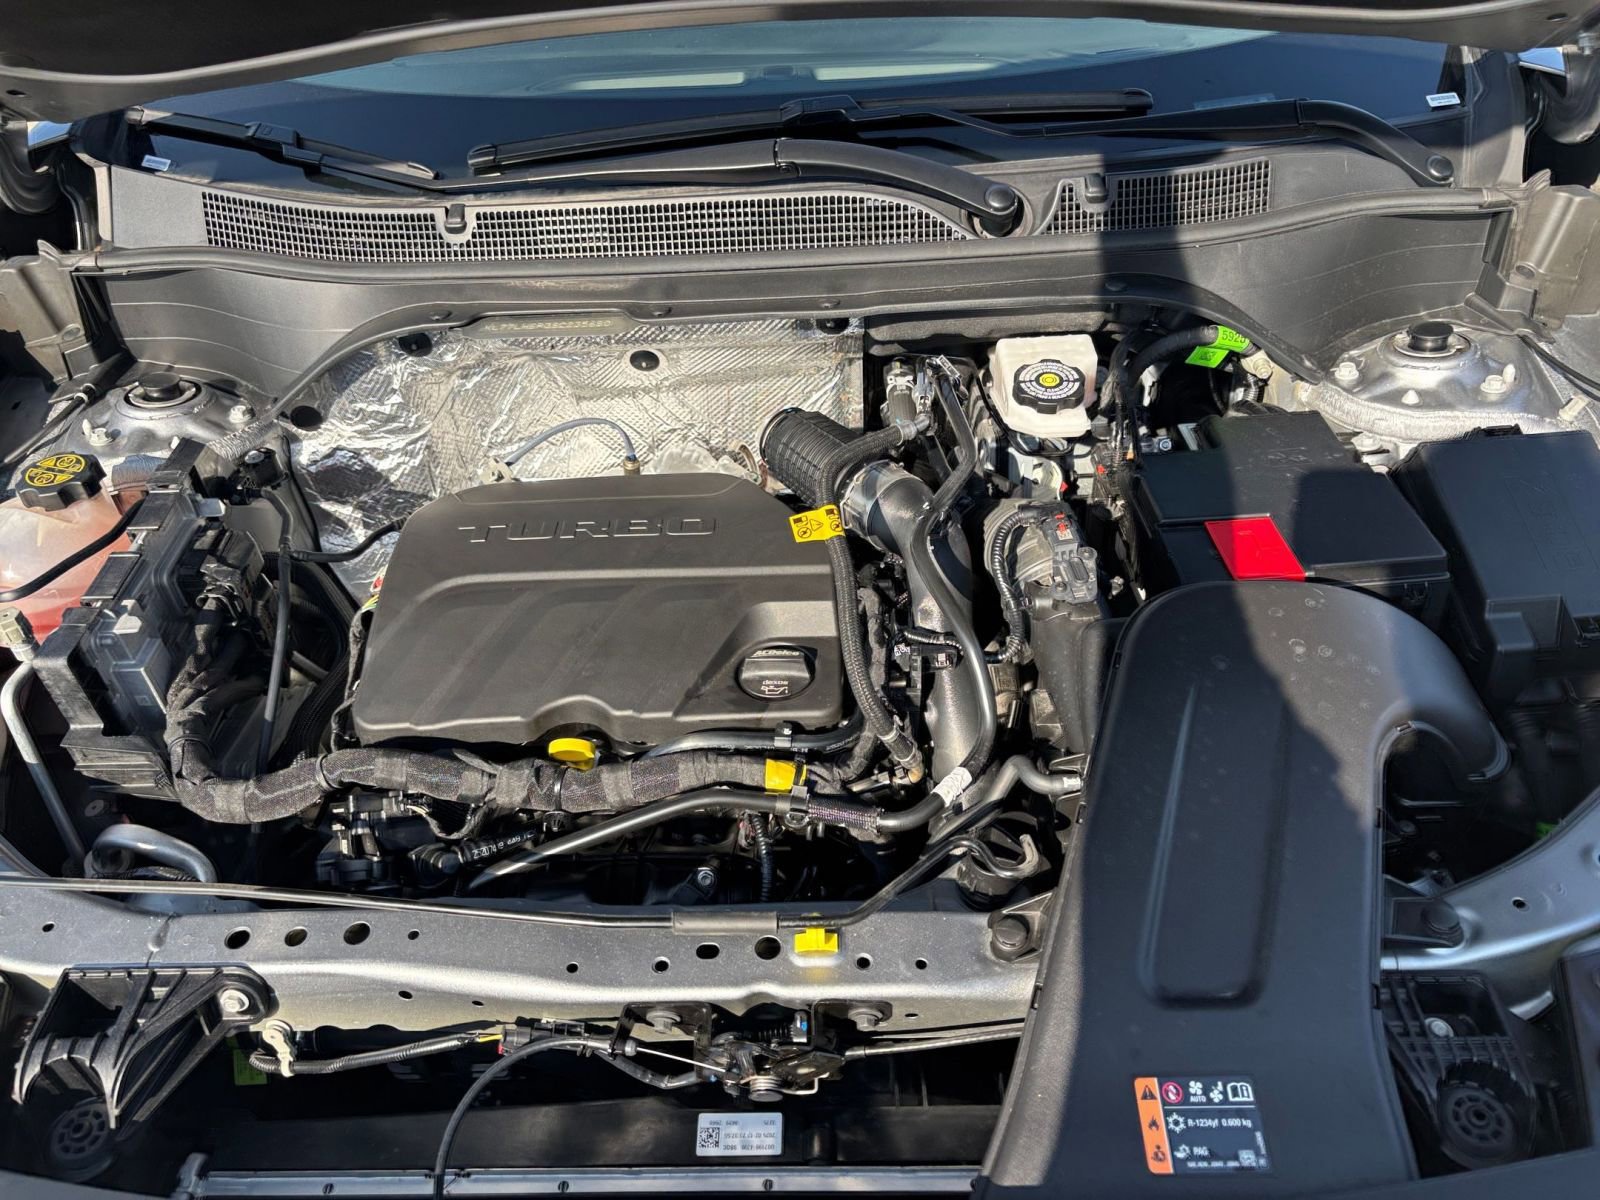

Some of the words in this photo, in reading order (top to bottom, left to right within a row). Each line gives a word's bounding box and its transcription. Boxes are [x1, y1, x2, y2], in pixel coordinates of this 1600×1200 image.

[458, 518, 717, 543] TURBO
[750, 649, 800, 657] ACDelco
[1190, 1095, 1206, 1103] AUTO
[1187, 1118, 1219, 1128] R-1234yf
[1221, 1118, 1241, 1127] 0.600
[1241, 1118, 1252, 1128] kg
